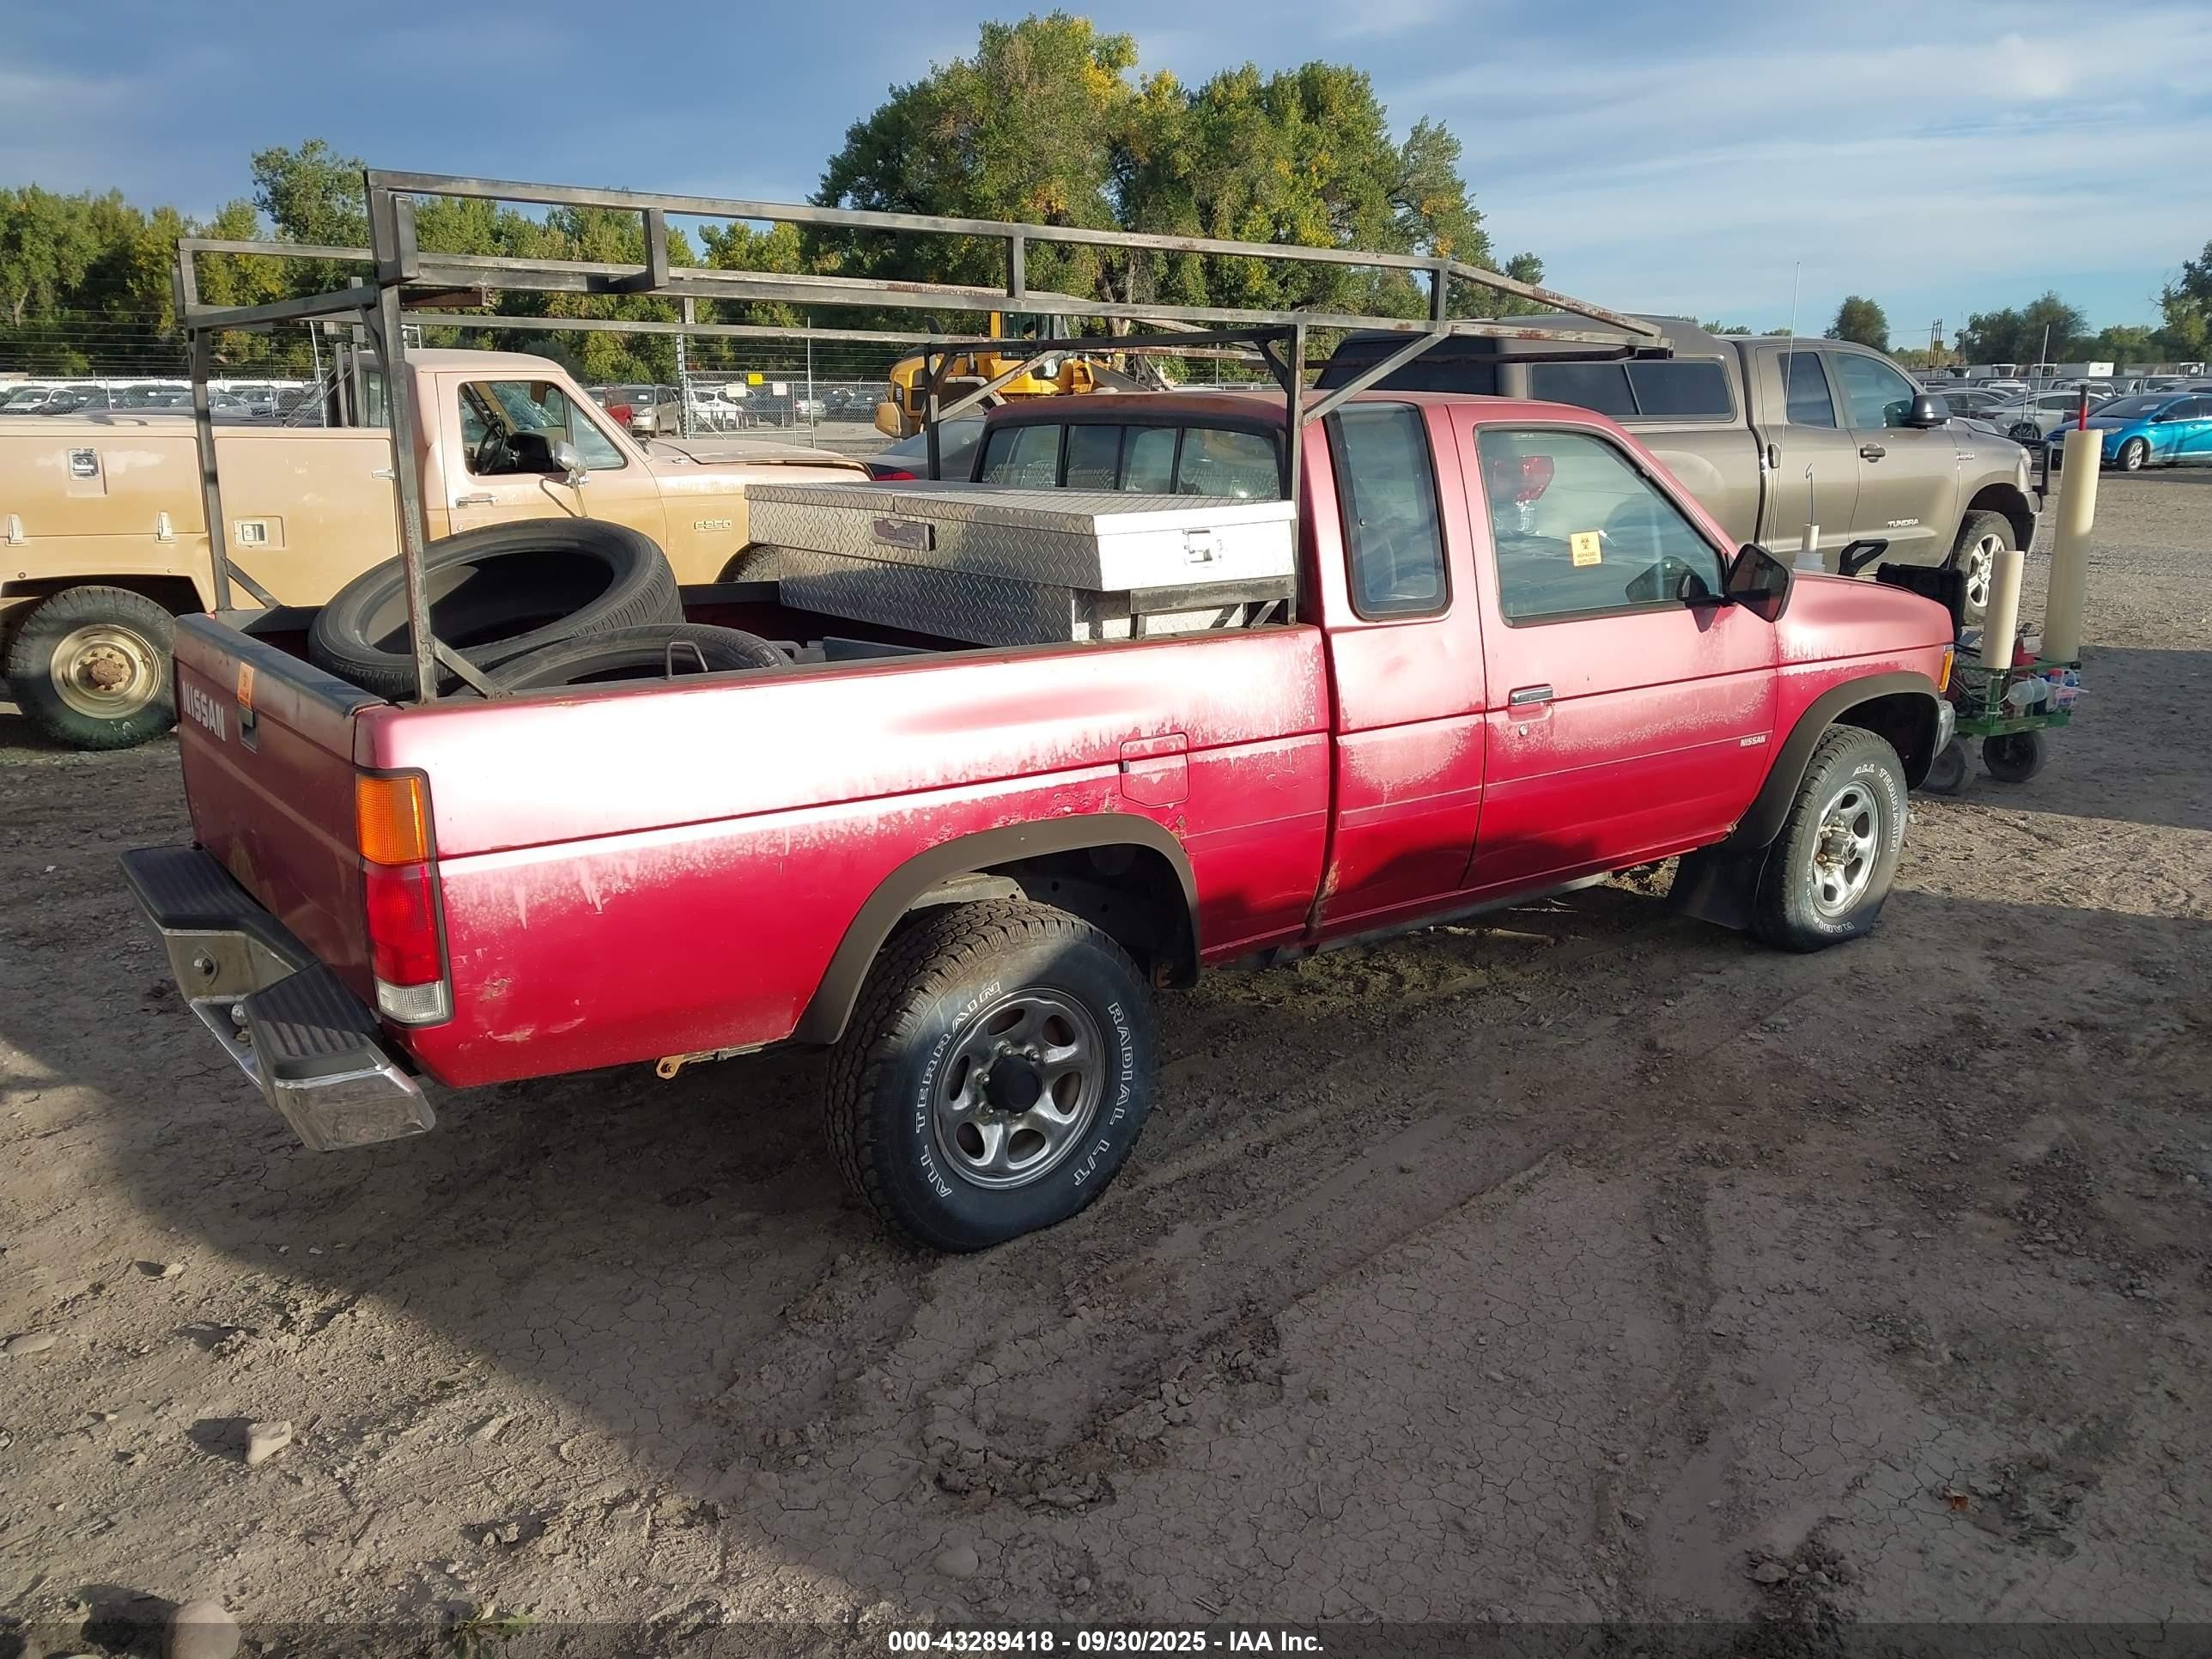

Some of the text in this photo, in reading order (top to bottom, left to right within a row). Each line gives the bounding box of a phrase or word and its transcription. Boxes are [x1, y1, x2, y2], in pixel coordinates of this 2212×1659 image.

[1887, 518, 1919, 528] TUNDRA
[182, 680, 226, 742] NISSAN
[1740, 734, 1766, 748] NISSAN
[1852, 763, 1900, 853] ALL TERRAIN
[915, 981, 1001, 1198] ALL TERRAIN
[1073, 1002, 1134, 1186] RADIAL L/T
